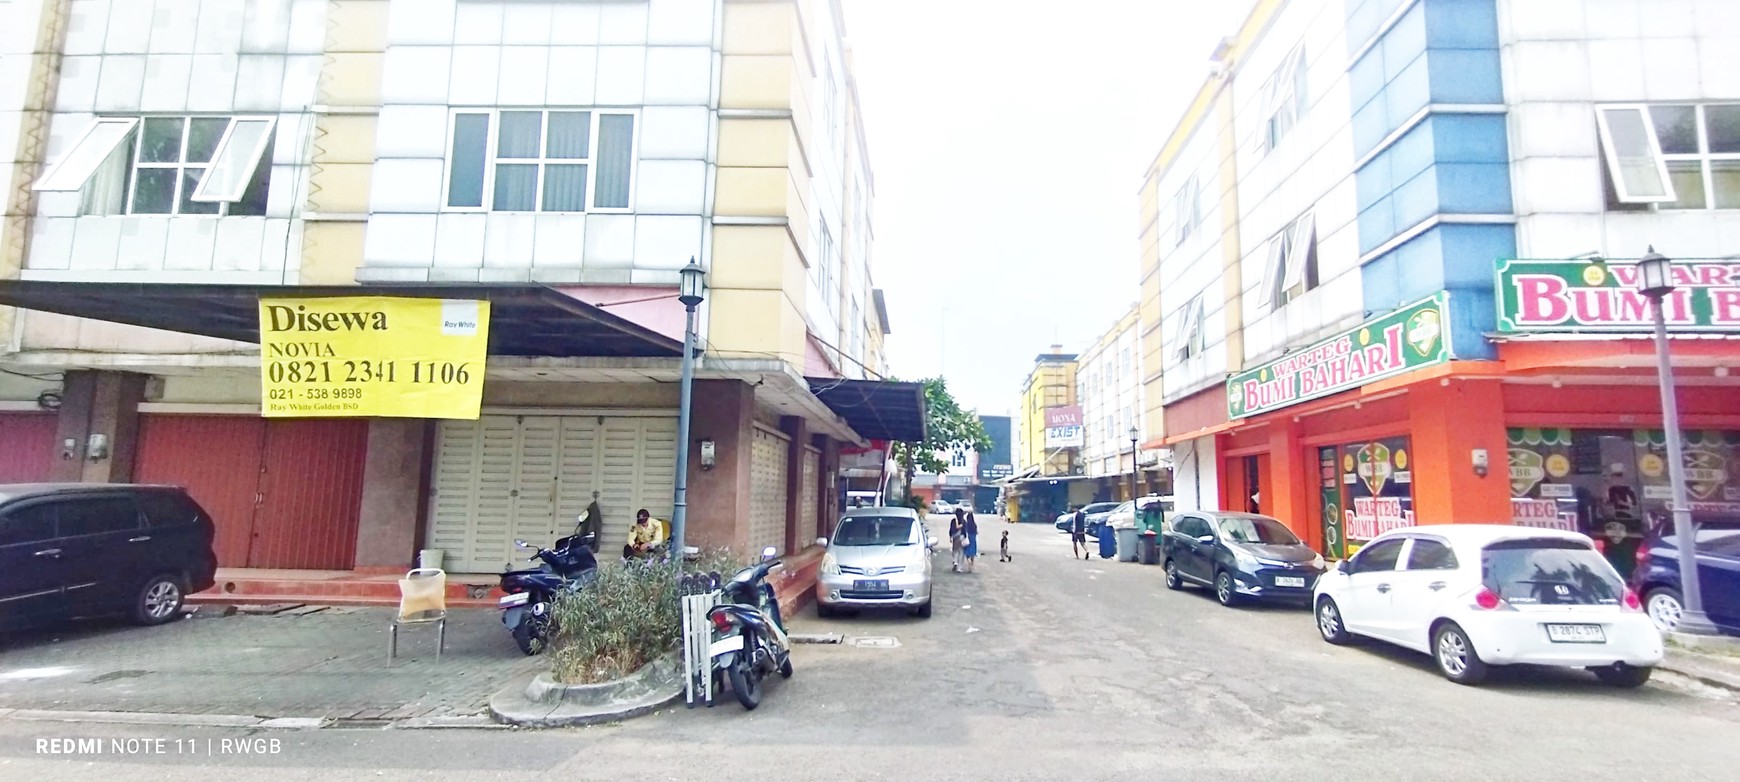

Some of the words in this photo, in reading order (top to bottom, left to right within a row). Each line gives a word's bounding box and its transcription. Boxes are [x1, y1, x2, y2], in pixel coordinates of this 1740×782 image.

[1517, 278, 1688, 322] BUMI
[267, 304, 388, 332] Disewa
[444, 320, 457, 329] Ray
[458, 320, 476, 329] White
[269, 342, 336, 357] NOVIA
[1273, 337, 1350, 378] WARTEG
[269, 361, 332, 383] 0821
[343, 360, 396, 383] 2341
[411, 361, 469, 384] 1106
[1244, 376, 1294, 410] BUMI
[1301, 326, 1403, 395] BAHARI
[269, 388, 293, 400] 021
[306, 388, 328, 399] 538
[333, 388, 362, 399] 9898
[270, 403, 287, 412] Ray
[289, 403, 312, 411] White
[313, 403, 341, 411] Golden
[1051, 425, 1080, 438] EXIST
